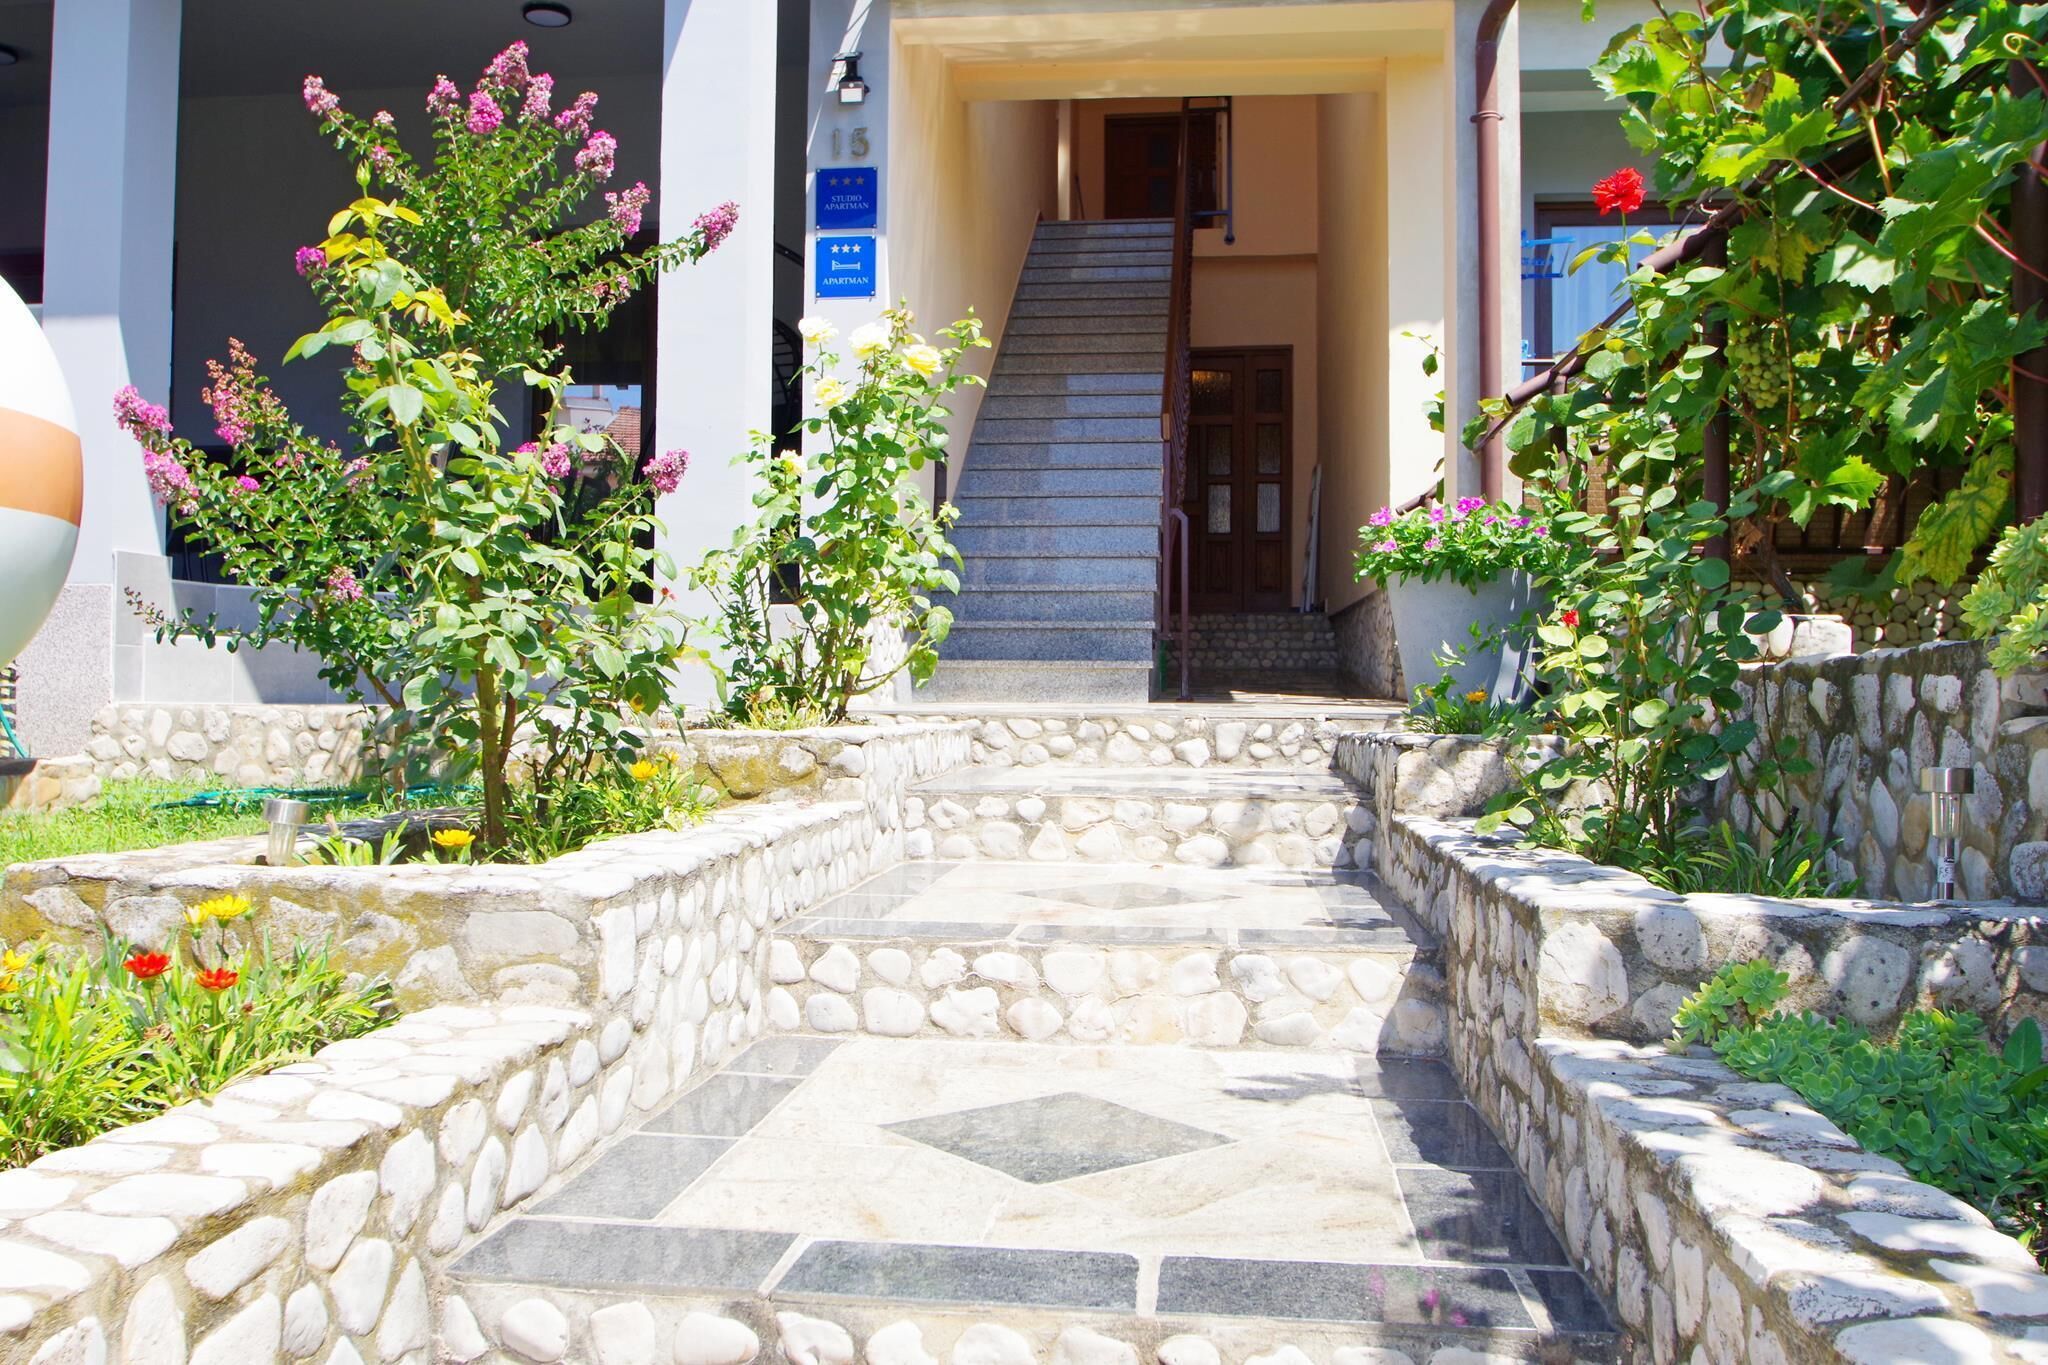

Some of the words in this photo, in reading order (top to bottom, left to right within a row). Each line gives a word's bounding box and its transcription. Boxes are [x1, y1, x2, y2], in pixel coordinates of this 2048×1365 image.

[831, 127, 870, 158] 15
[831, 194, 863, 203] STUDIO
[824, 202, 870, 210] APARTMAN
[822, 276, 869, 286] APARTMAN
